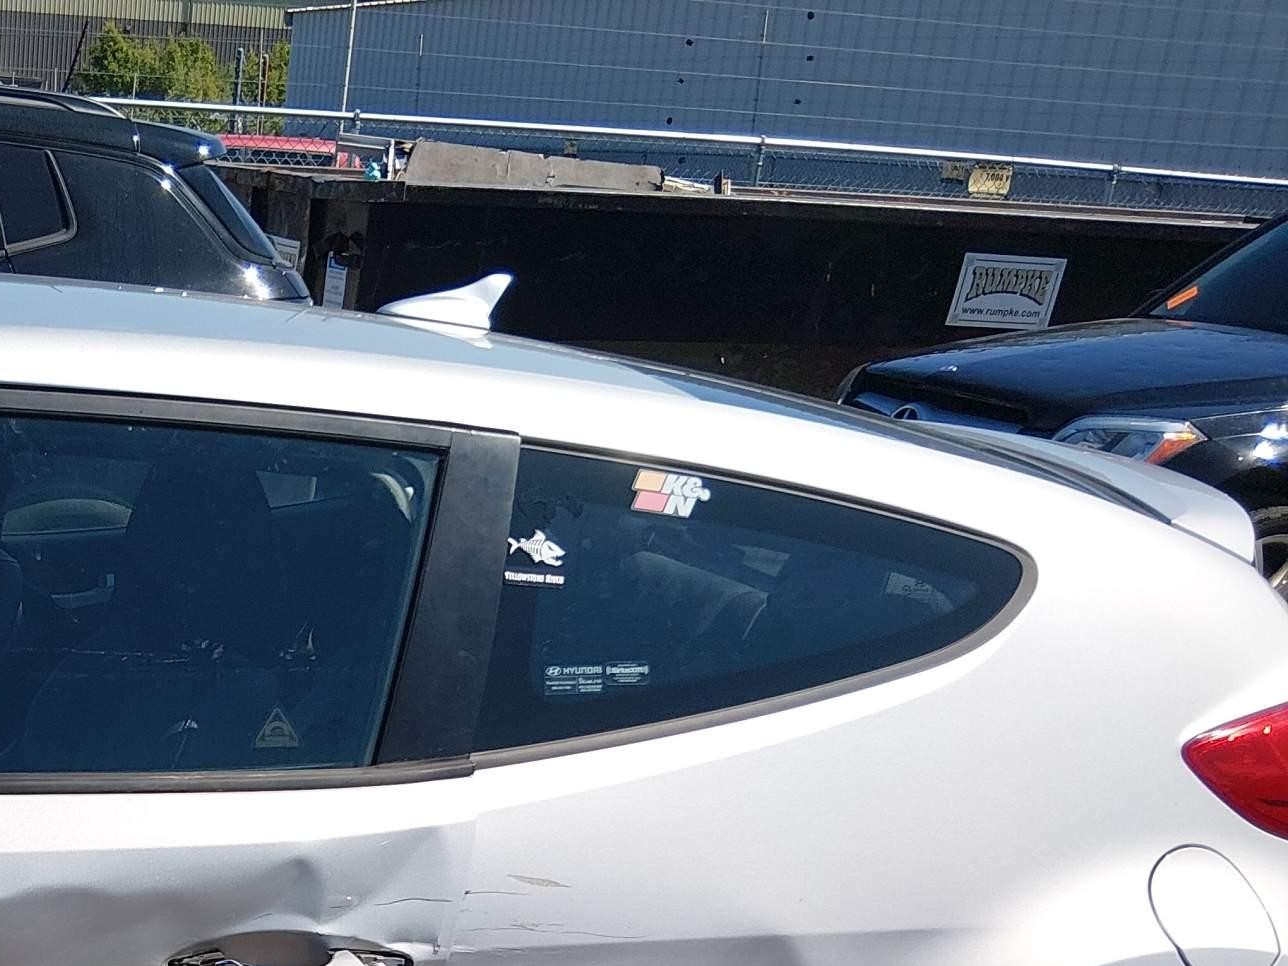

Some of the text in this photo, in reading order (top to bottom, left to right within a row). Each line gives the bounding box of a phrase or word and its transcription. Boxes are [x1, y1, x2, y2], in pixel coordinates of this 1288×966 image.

[965, 265, 1053, 306] RUMPKE
[962, 307, 1040, 319] www.rumpke.com
[563, 665, 603, 675] HYUNDAI
